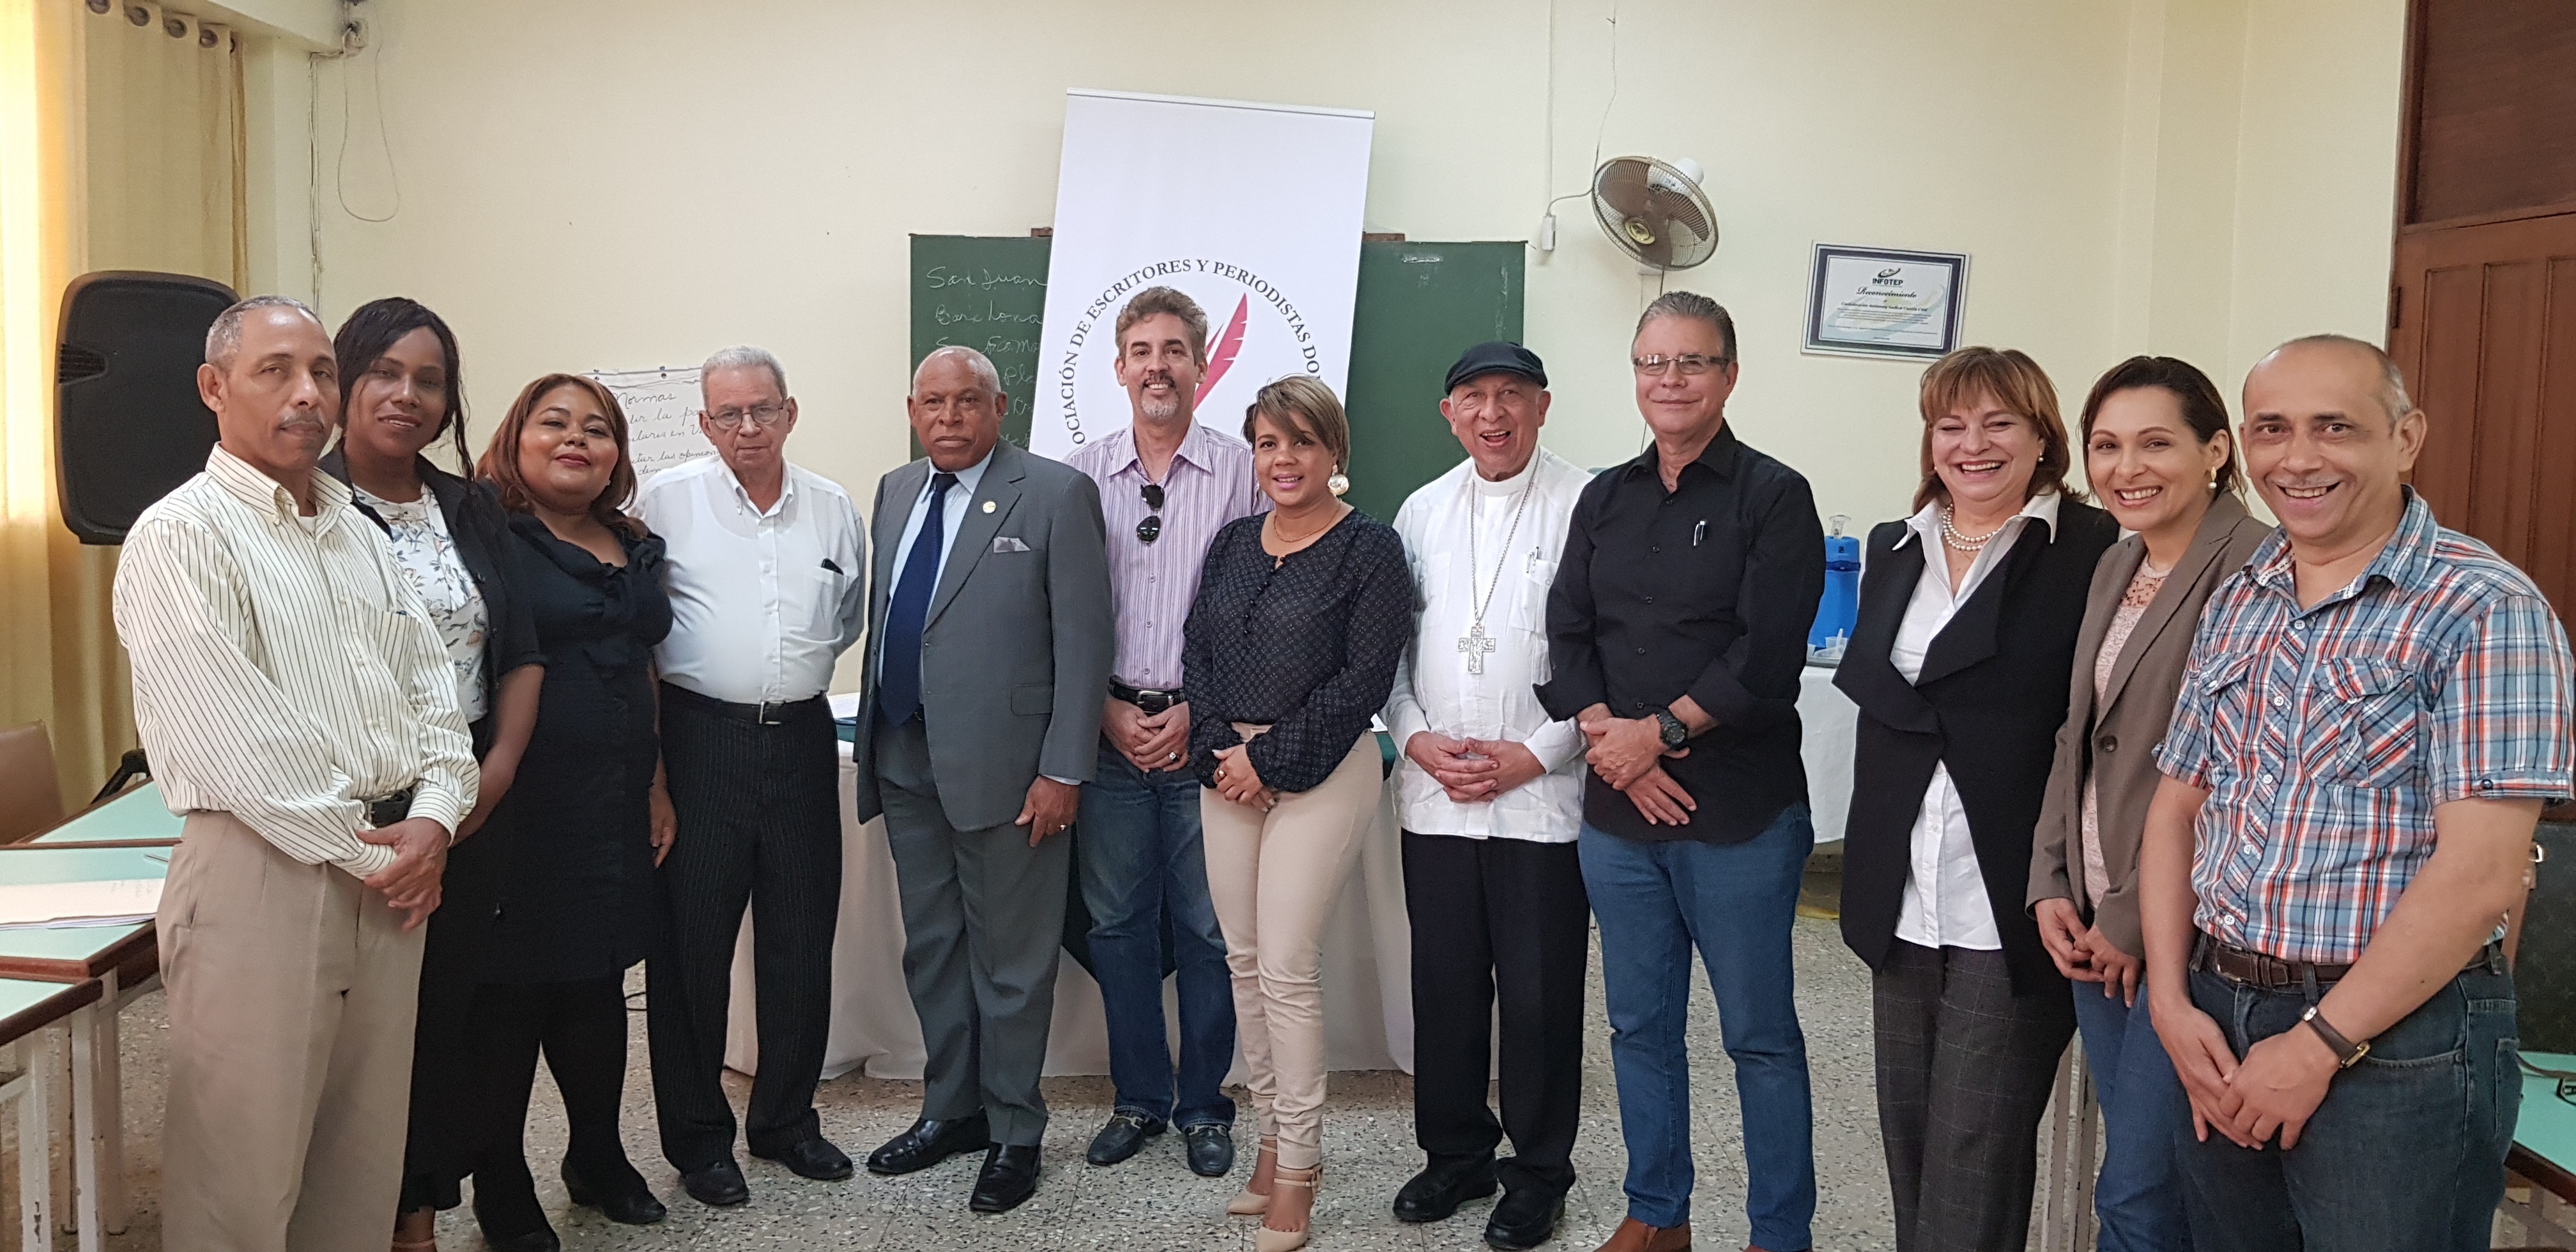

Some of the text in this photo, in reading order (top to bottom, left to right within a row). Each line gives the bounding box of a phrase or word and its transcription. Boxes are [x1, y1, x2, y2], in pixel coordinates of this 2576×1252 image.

[926, 266, 976, 288] San
[1196, 259, 1209, 272] Y
[1085, 259, 1192, 321] ESCRITORES
[1855, 286, 1917, 298] Reconocimiento
[1872, 278, 1903, 286] INFOTEP
[1213, 261, 1311, 342] PERIODISTAS
[1070, 321, 1091, 348] DE
[1302, 344, 1321, 379] DO
[612, 392, 677, 409] Normas
[1059, 350, 1086, 445] OCIACIÓN
